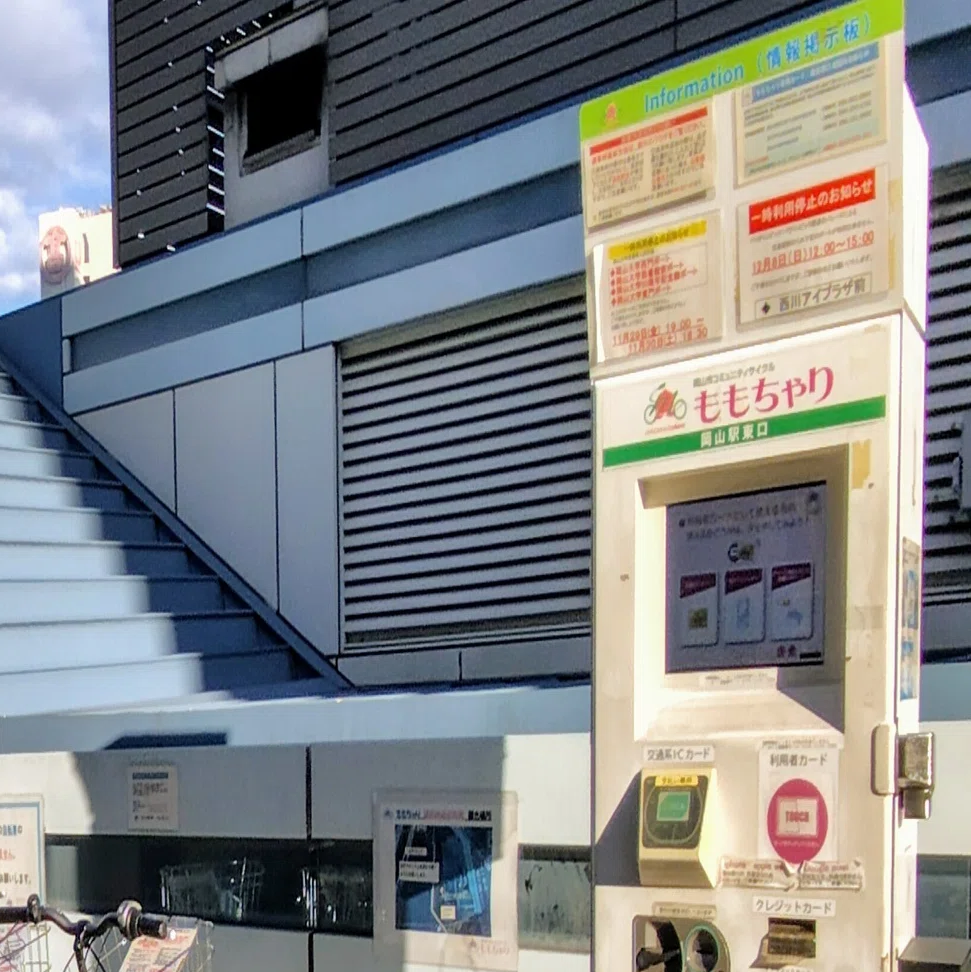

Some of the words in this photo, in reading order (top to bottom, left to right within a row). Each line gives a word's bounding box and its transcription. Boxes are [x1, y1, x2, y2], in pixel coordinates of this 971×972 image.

[644, 62, 744, 113] Information
[751, 180, 873, 222] 一時利用停止のお知らせ
[780, 278, 866, 312] 西川アイプラザ前
[694, 366, 835, 424] ももちゃり
[700, 421, 769, 448] 岡山駅東口
[647, 747, 710, 762] 交通系ICカード
[770, 752, 828, 768] 利用者カード
[756, 899, 832, 914] クレジットカード
